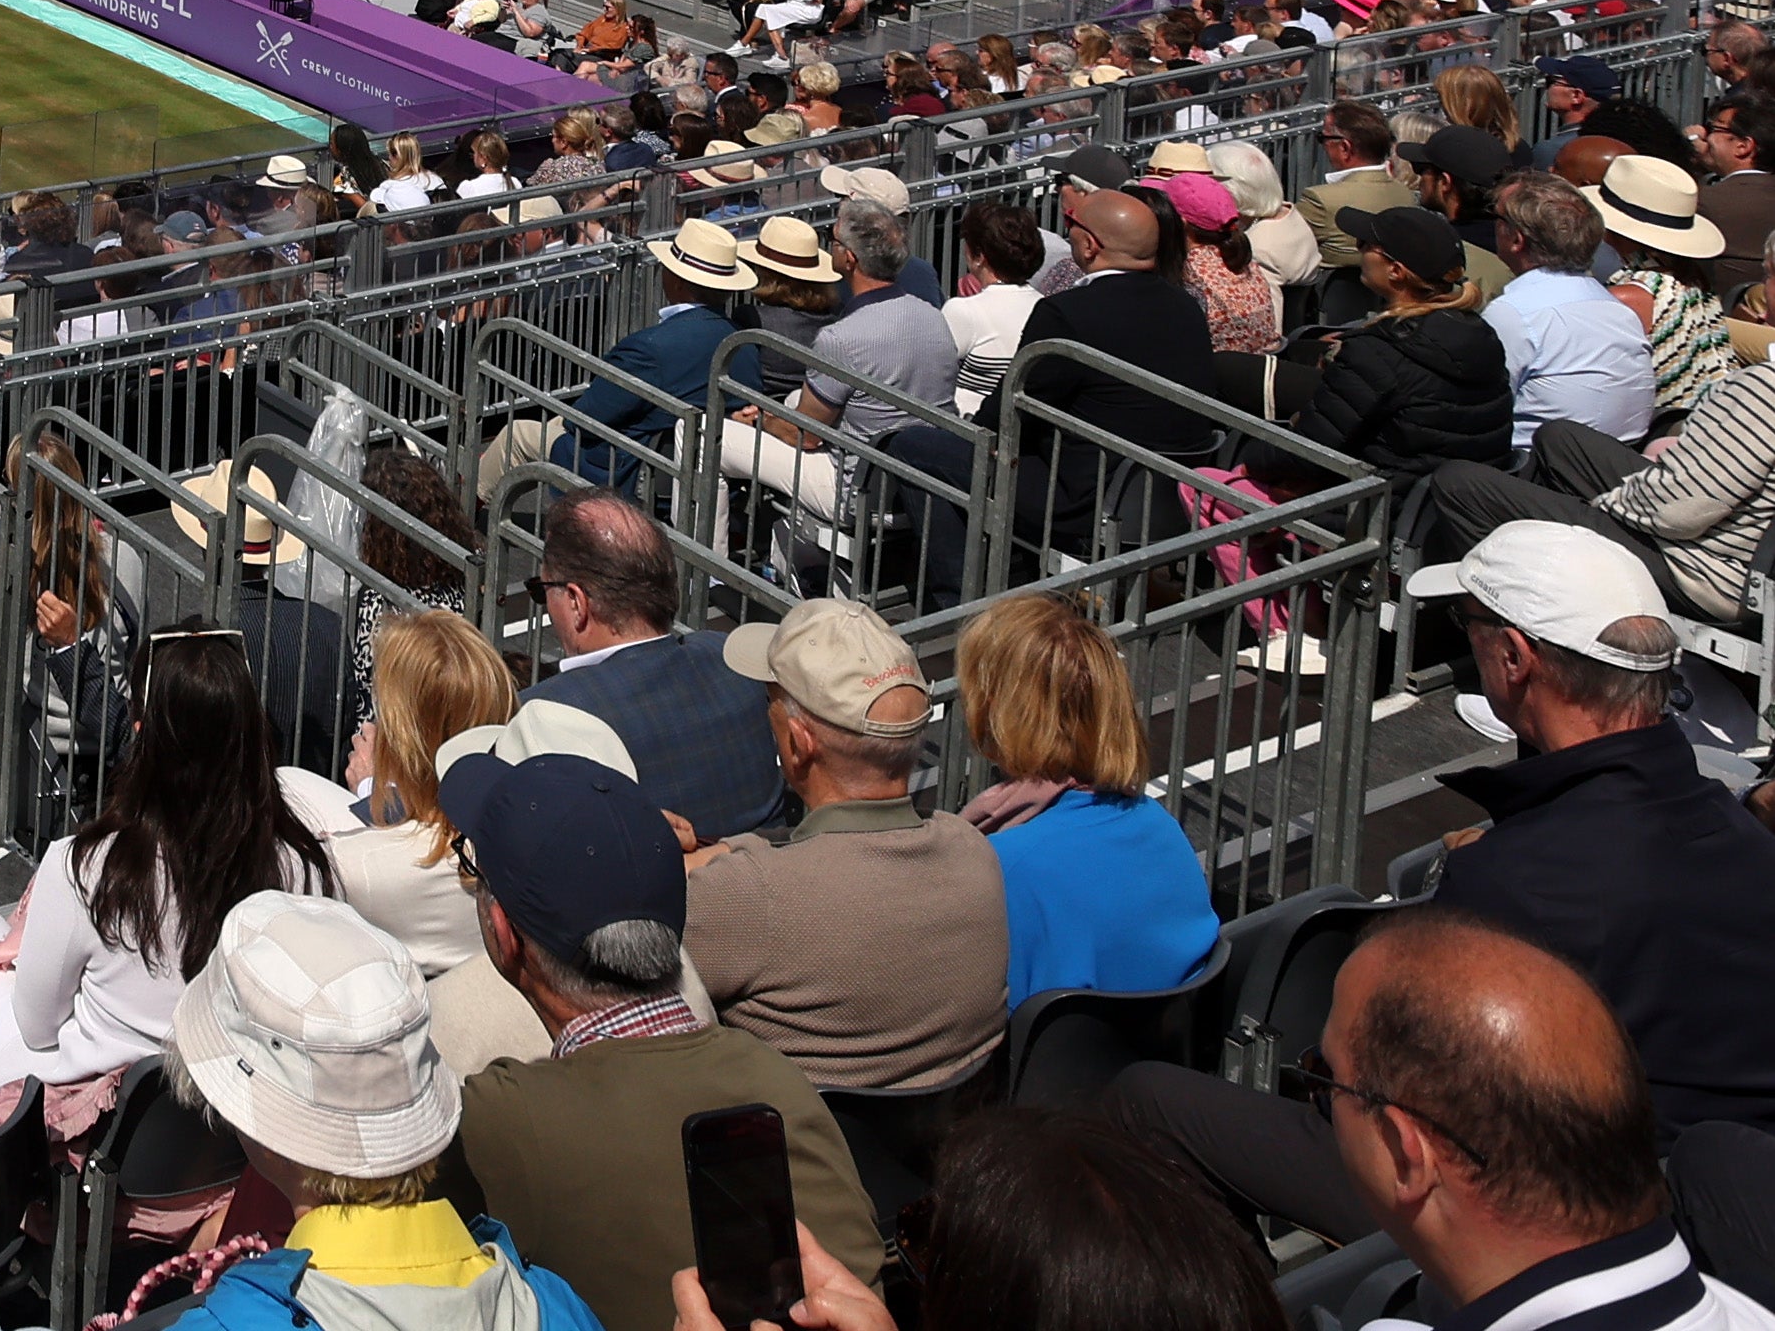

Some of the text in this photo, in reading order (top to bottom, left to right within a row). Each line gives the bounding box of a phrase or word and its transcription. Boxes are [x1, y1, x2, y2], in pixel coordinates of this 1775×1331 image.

[301, 58, 331, 77] CREW
[335, 71, 390, 102] CLOTHING
[1470, 574, 1500, 600] croatia
